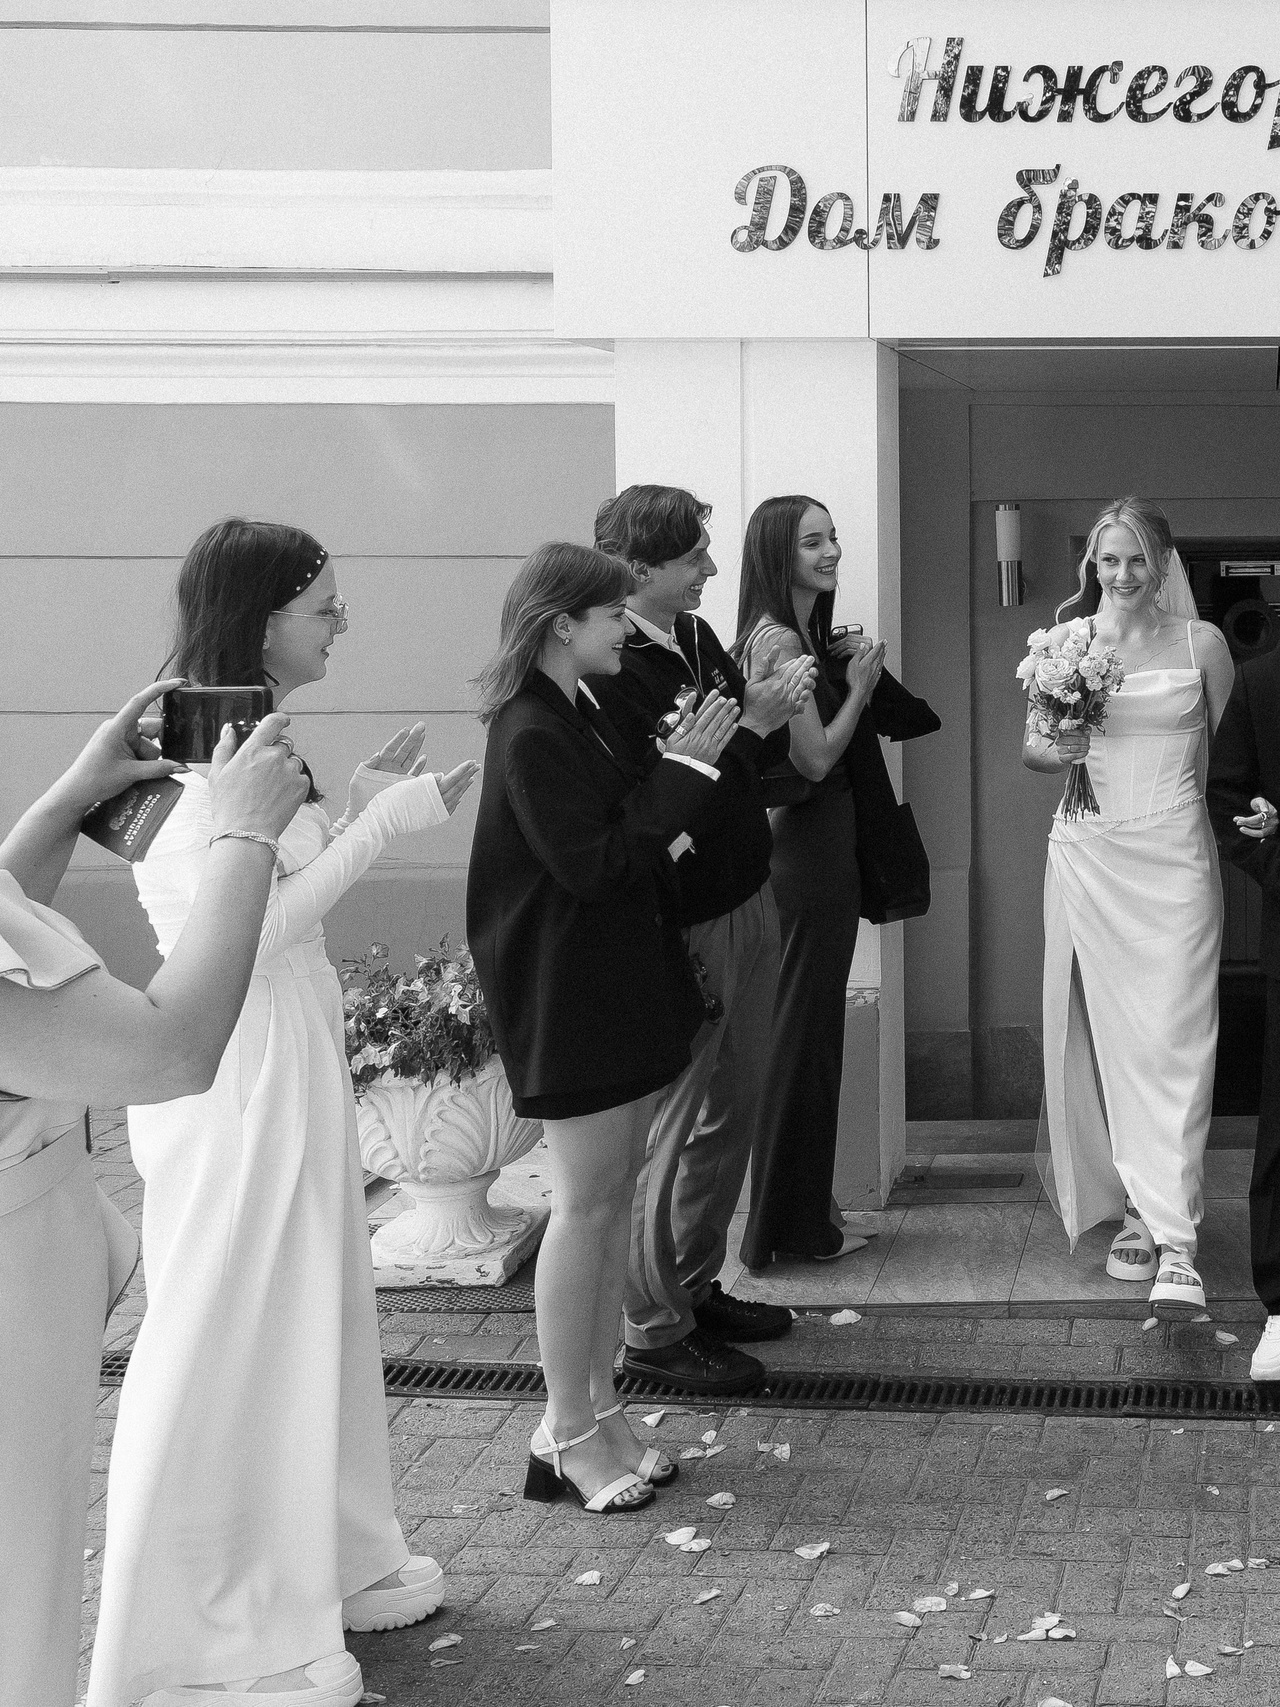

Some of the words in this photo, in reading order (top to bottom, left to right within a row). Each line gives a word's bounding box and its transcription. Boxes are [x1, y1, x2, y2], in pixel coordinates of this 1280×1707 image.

[730, 164, 941, 253] Дом
[123, 794, 153, 841] ФЕДЕРАЦИЯ
[126, 793, 161, 846] РОССИЙСКАЯ
